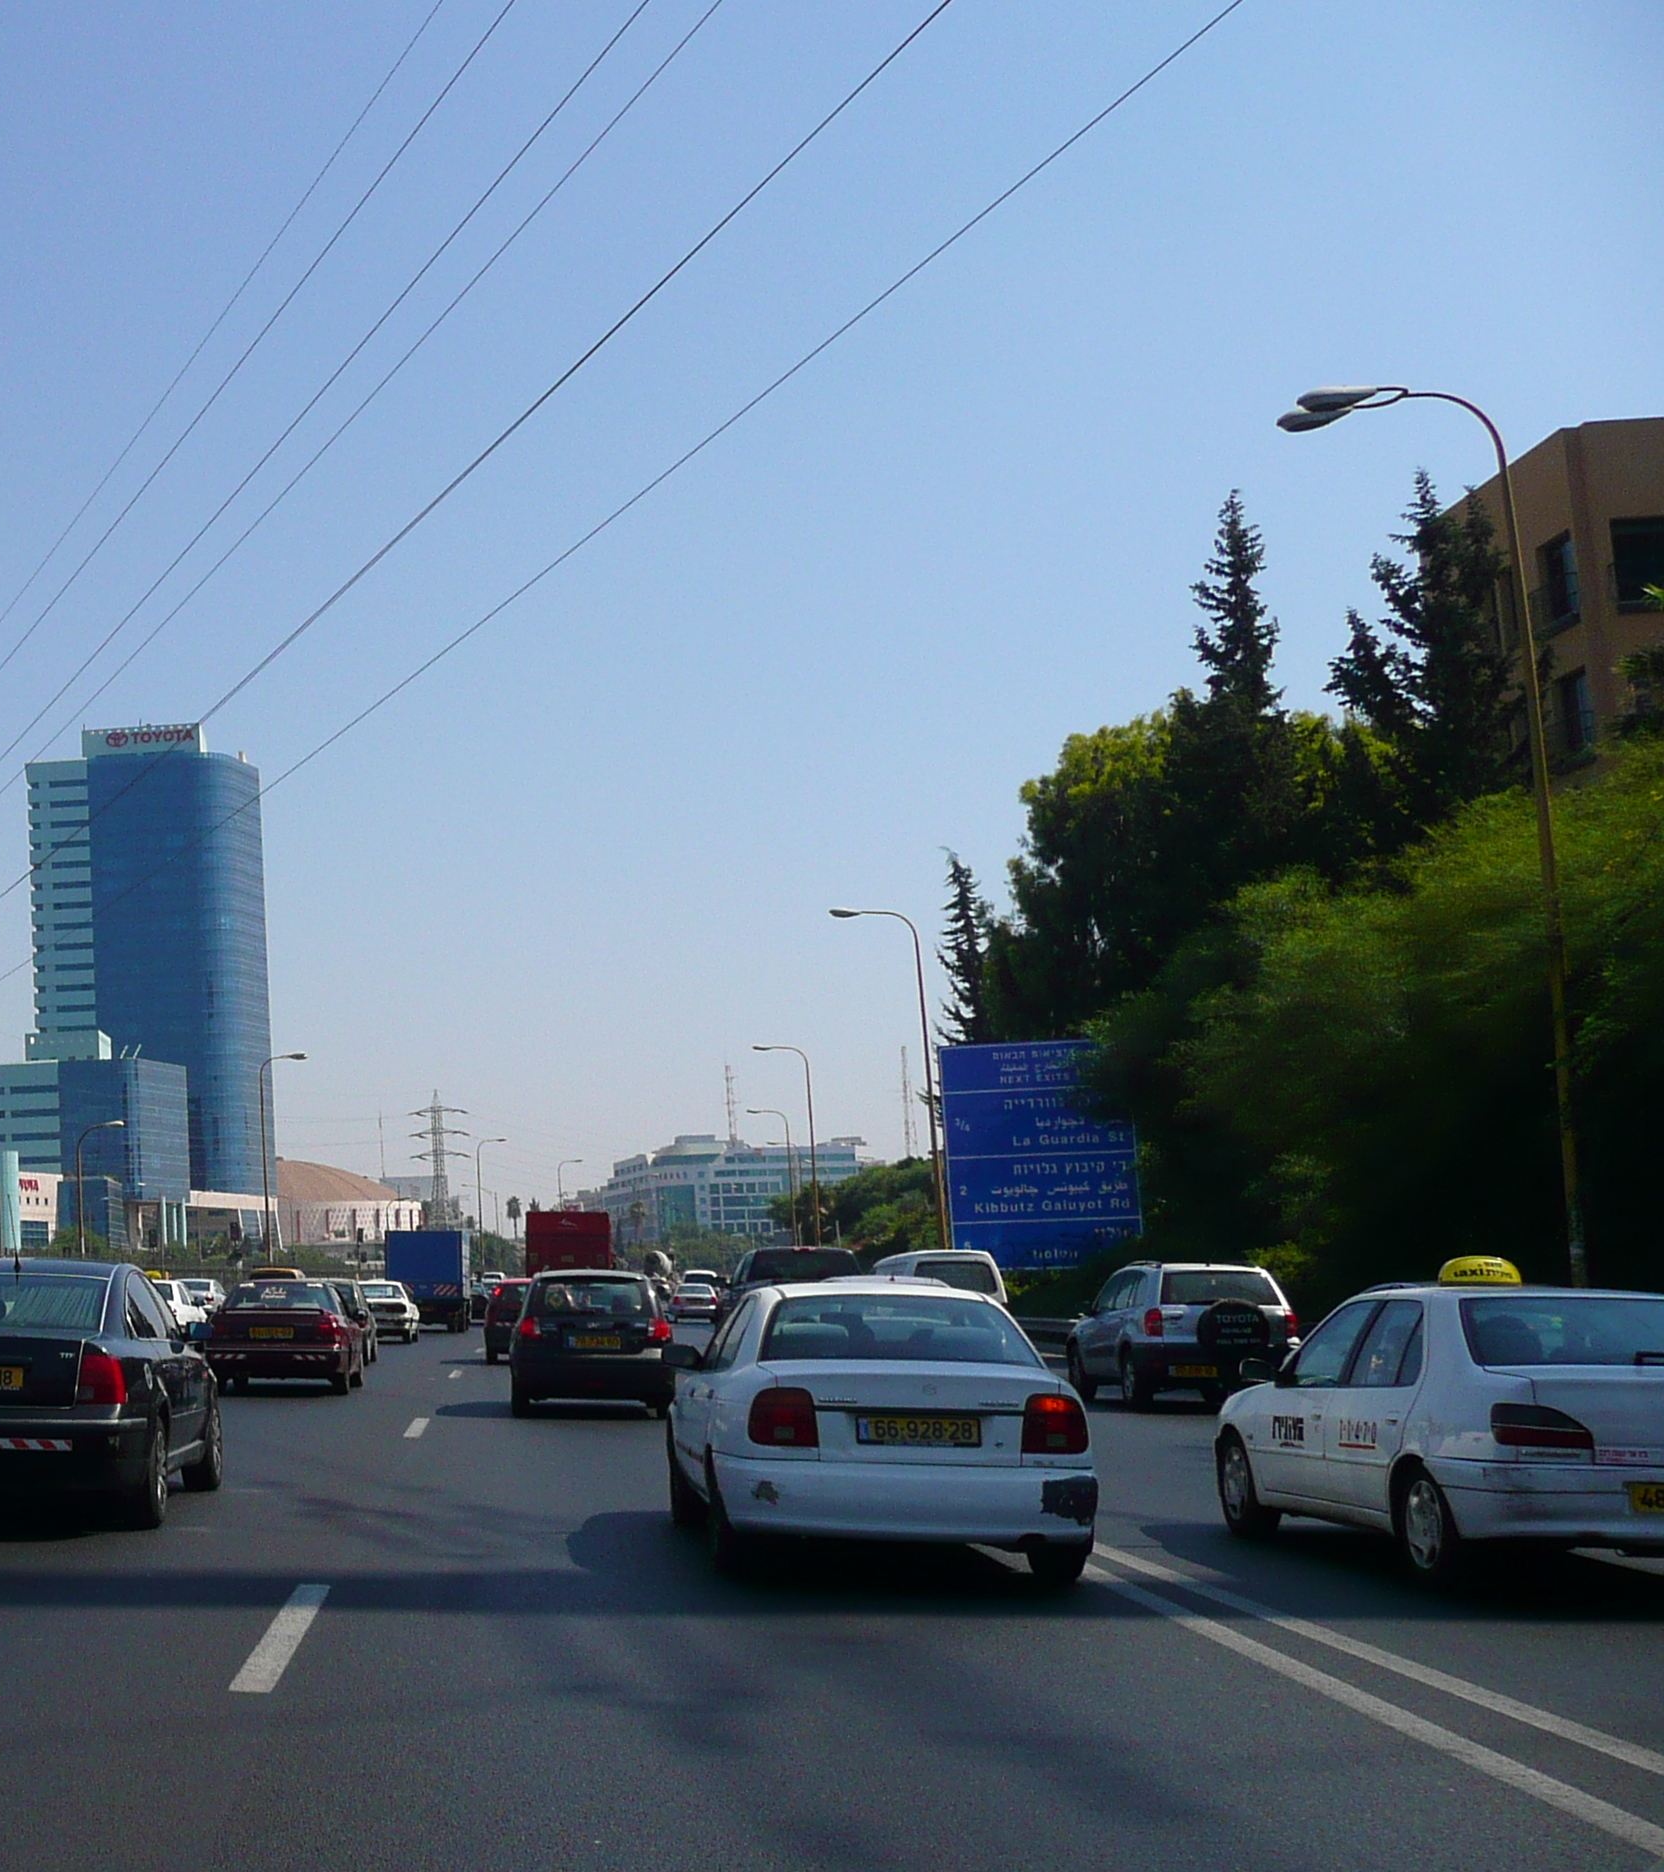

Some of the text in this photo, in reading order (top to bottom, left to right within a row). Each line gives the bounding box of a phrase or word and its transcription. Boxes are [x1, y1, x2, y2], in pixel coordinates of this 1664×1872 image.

[131, 729, 195, 745] TOYOTA
[1000, 1073, 1070, 1084] NEXT EXITS
[1013, 1131, 1125, 1146] La Guardia St
[1013, 1162, 1058, 1175] גלויות
[1065, 1161, 1105, 1175] קיבוץ
[959, 1186, 967, 1195] 2
[974, 1197, 1130, 1214] Kibbutz Galuyot Rd
[1454, 1268, 1484, 1278] taxi
[1216, 1314, 1260, 1324] TOYOTA
